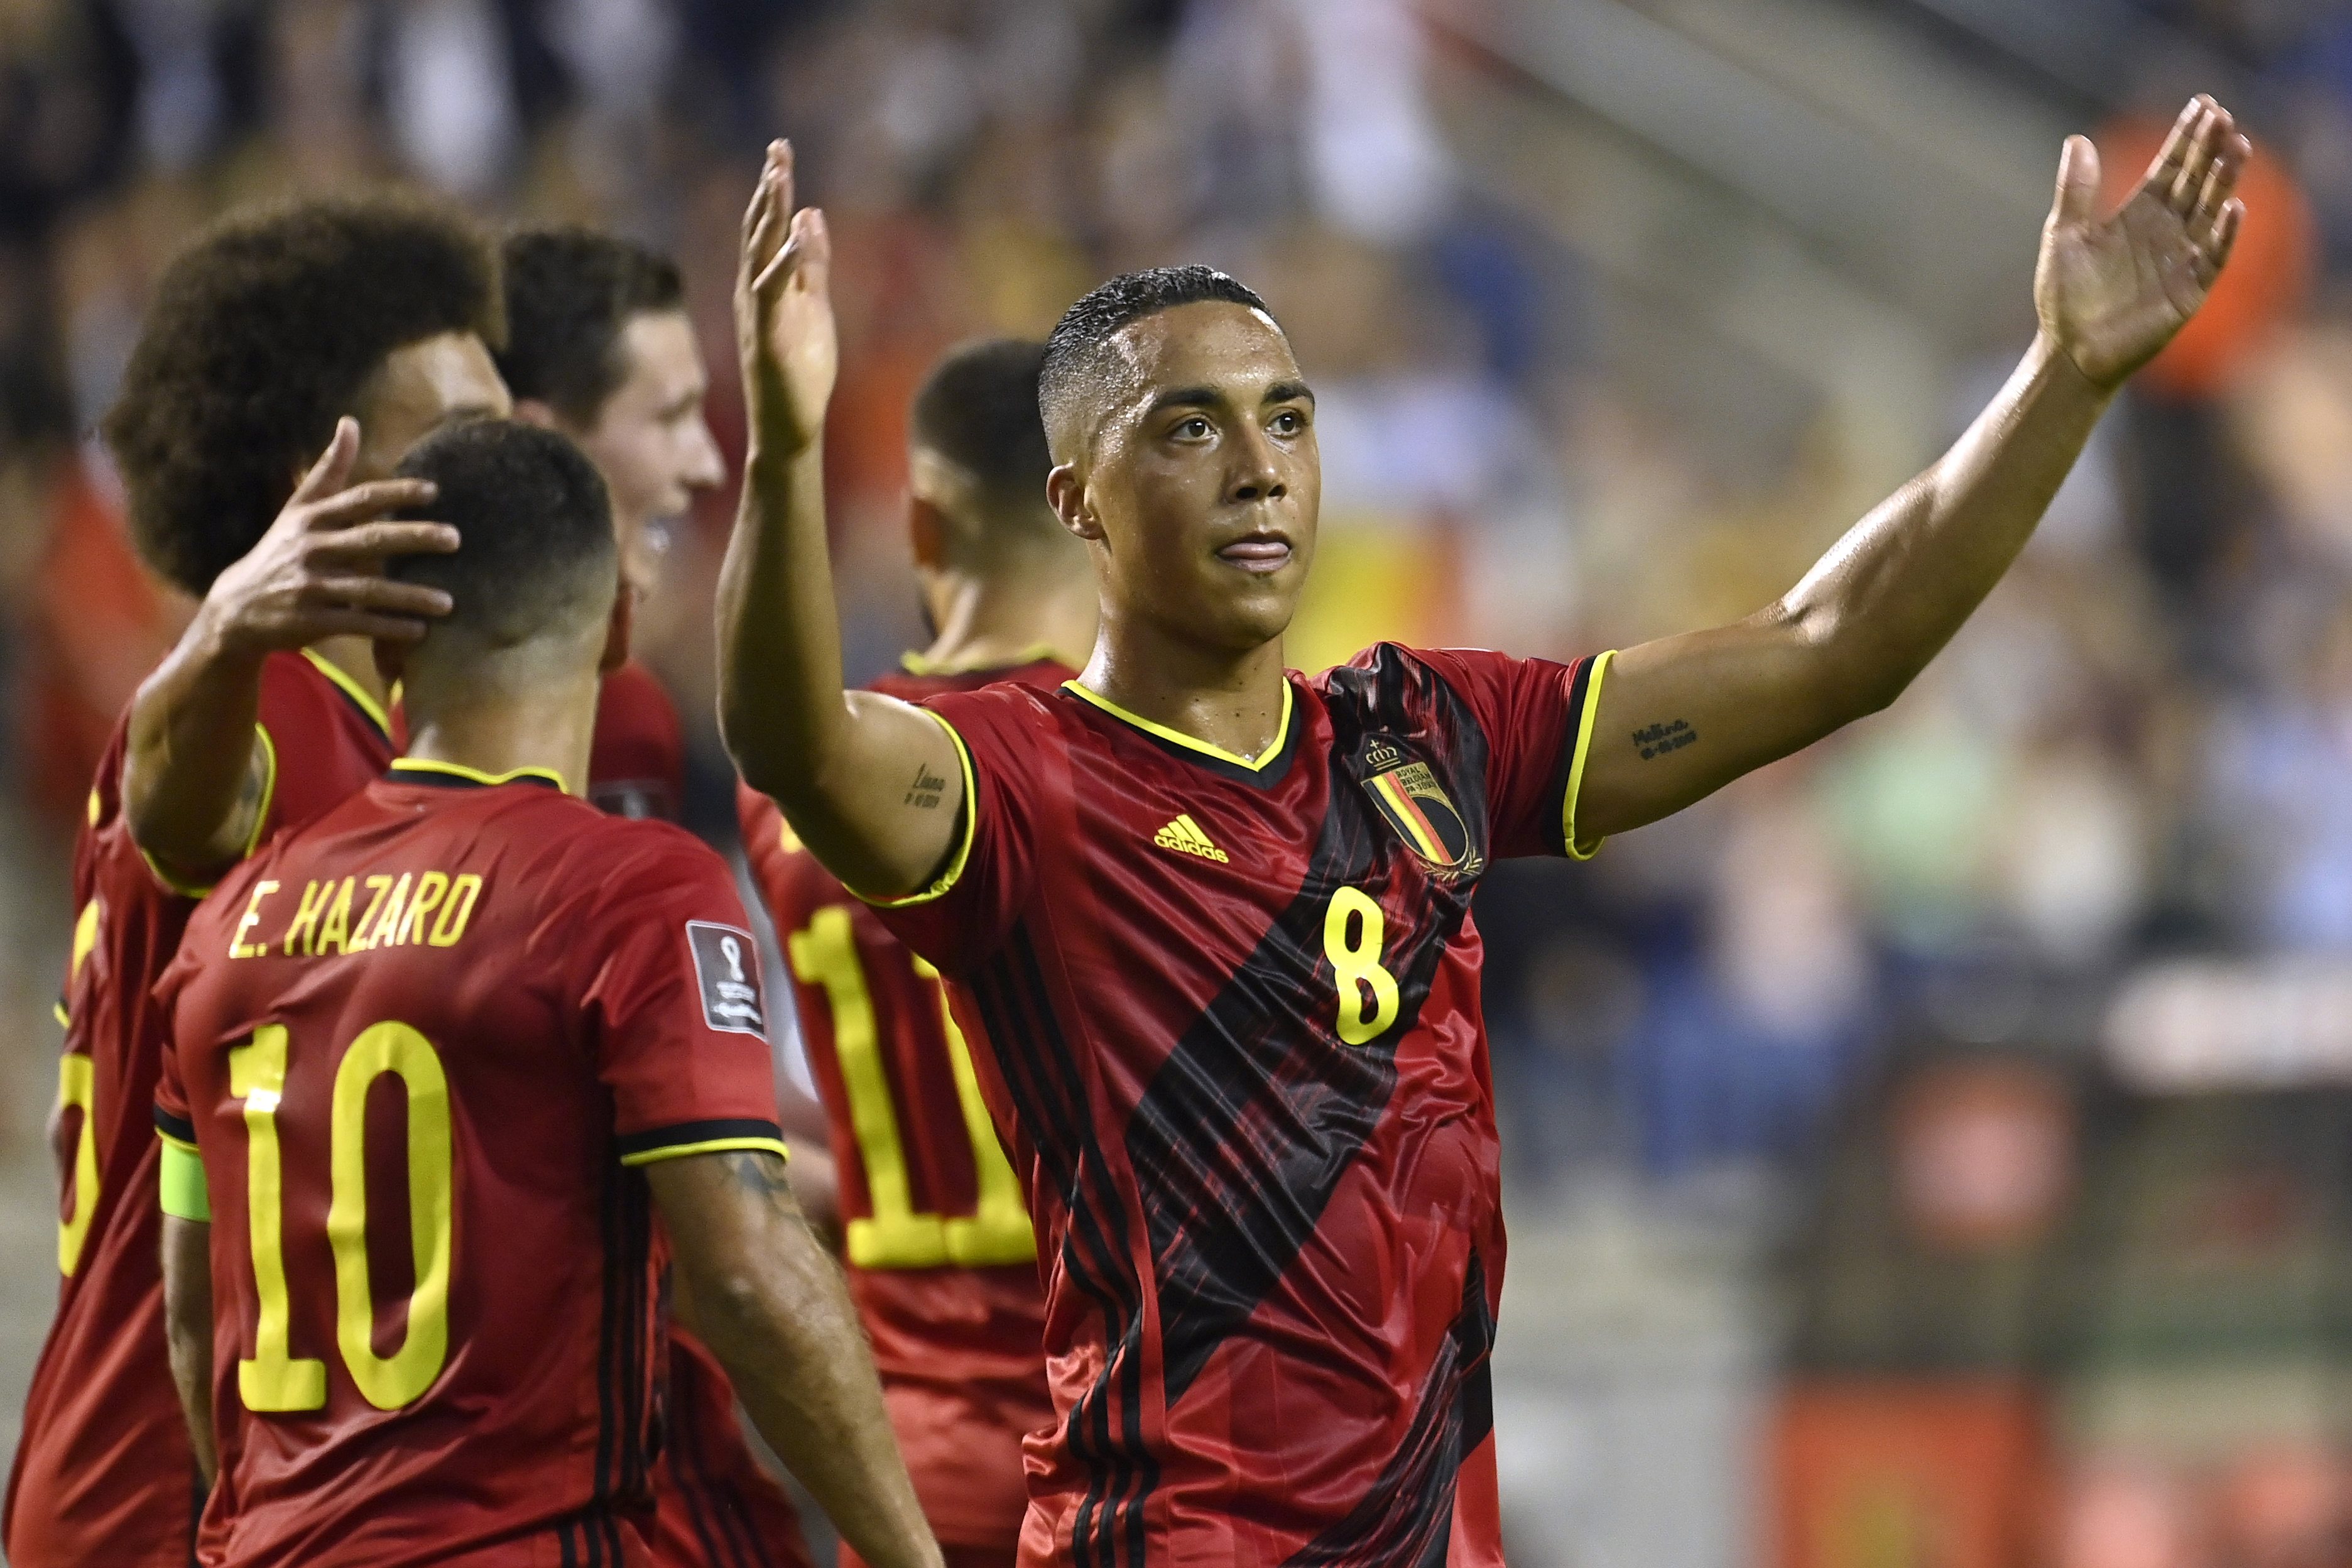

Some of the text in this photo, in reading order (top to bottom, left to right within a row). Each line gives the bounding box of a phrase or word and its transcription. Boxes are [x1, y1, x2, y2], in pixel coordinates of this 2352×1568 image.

[1396, 766, 1420, 778] ROYAL
[1400, 773, 1430, 786] BELGIAN
[1154, 834, 1229, 864] adidas
[229, 871, 482, 959] E. HAZARD
[1323, 886, 1400, 1045] 8
[228, 1019, 452, 1412] 10
